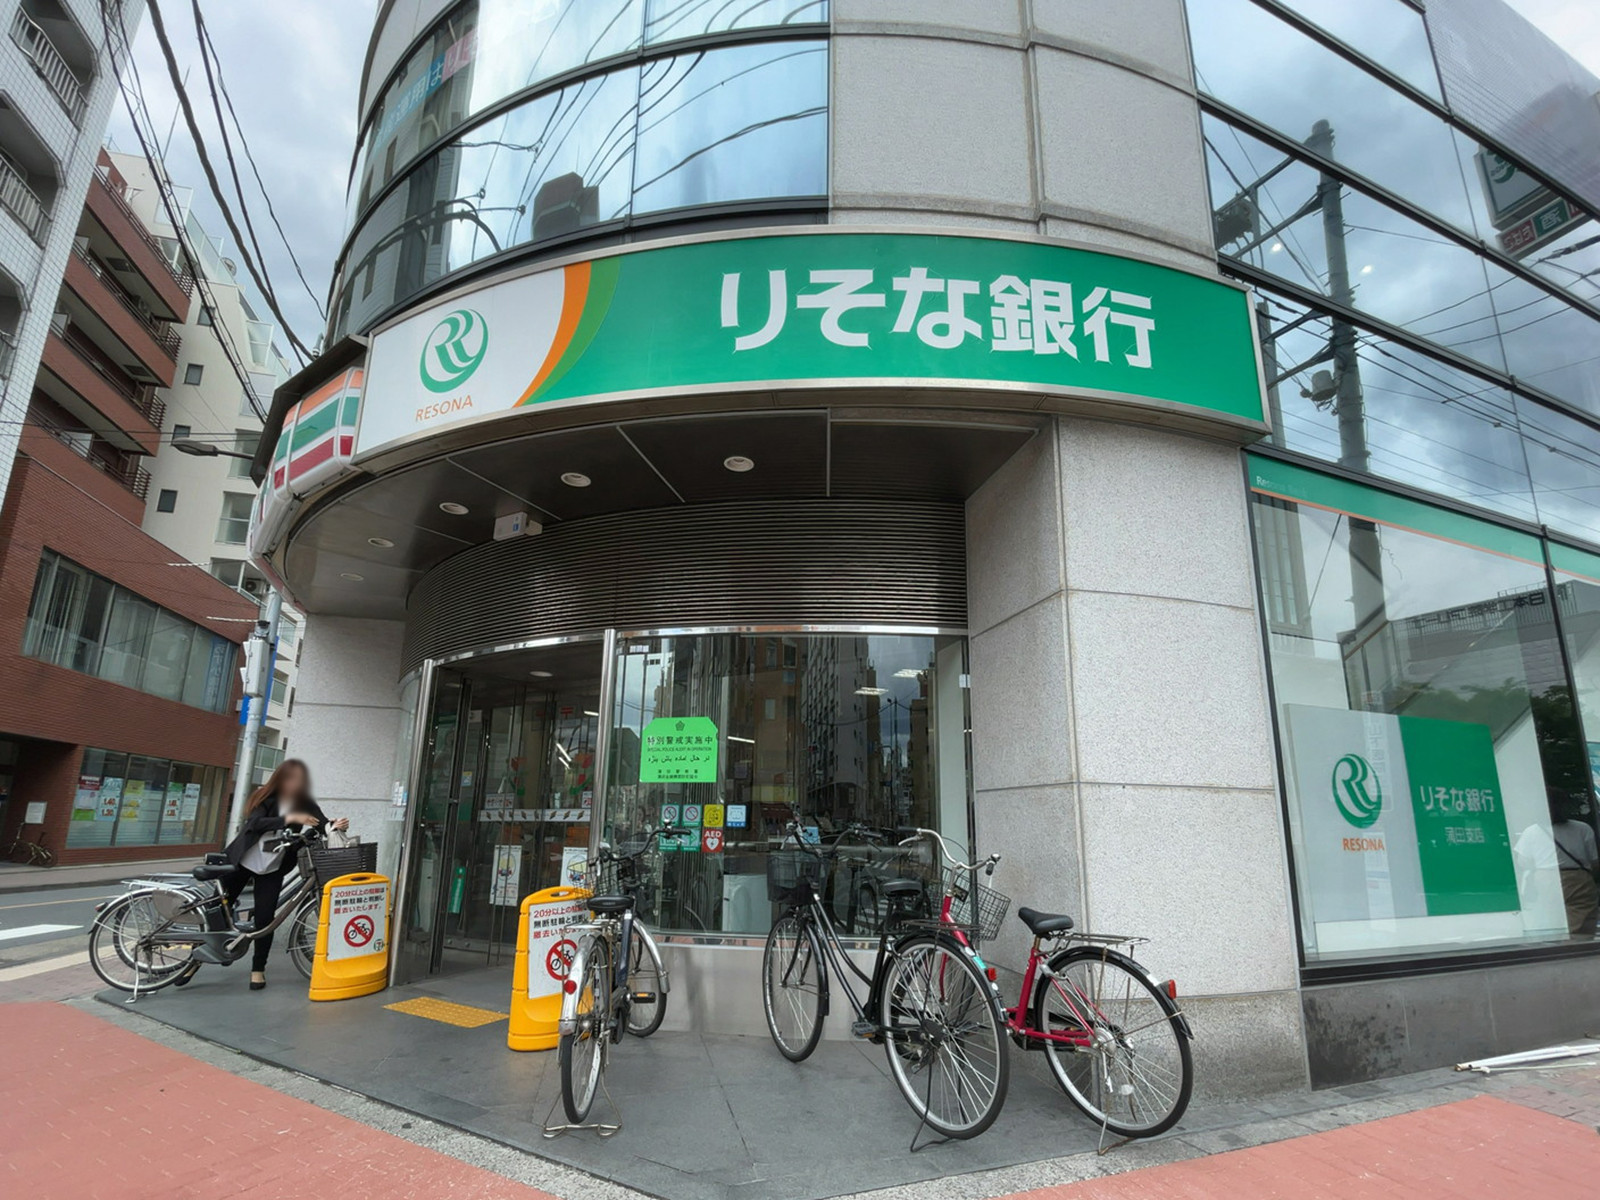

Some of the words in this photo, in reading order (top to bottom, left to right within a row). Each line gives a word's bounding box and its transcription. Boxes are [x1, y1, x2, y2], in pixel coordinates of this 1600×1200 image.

[719, 266, 1156, 369] りそな銀行
[415, 395, 473, 422] RESONA
[647, 736, 713, 745] 特別警戒実施中
[1420, 785, 1495, 813] りそな銀行
[704, 830, 722, 838] AED
[1342, 837, 1386, 852] RESONA
[335, 887, 385, 898] 20分以上の駐輪は
[334, 895, 385, 906] 無断駐輪と判断し
